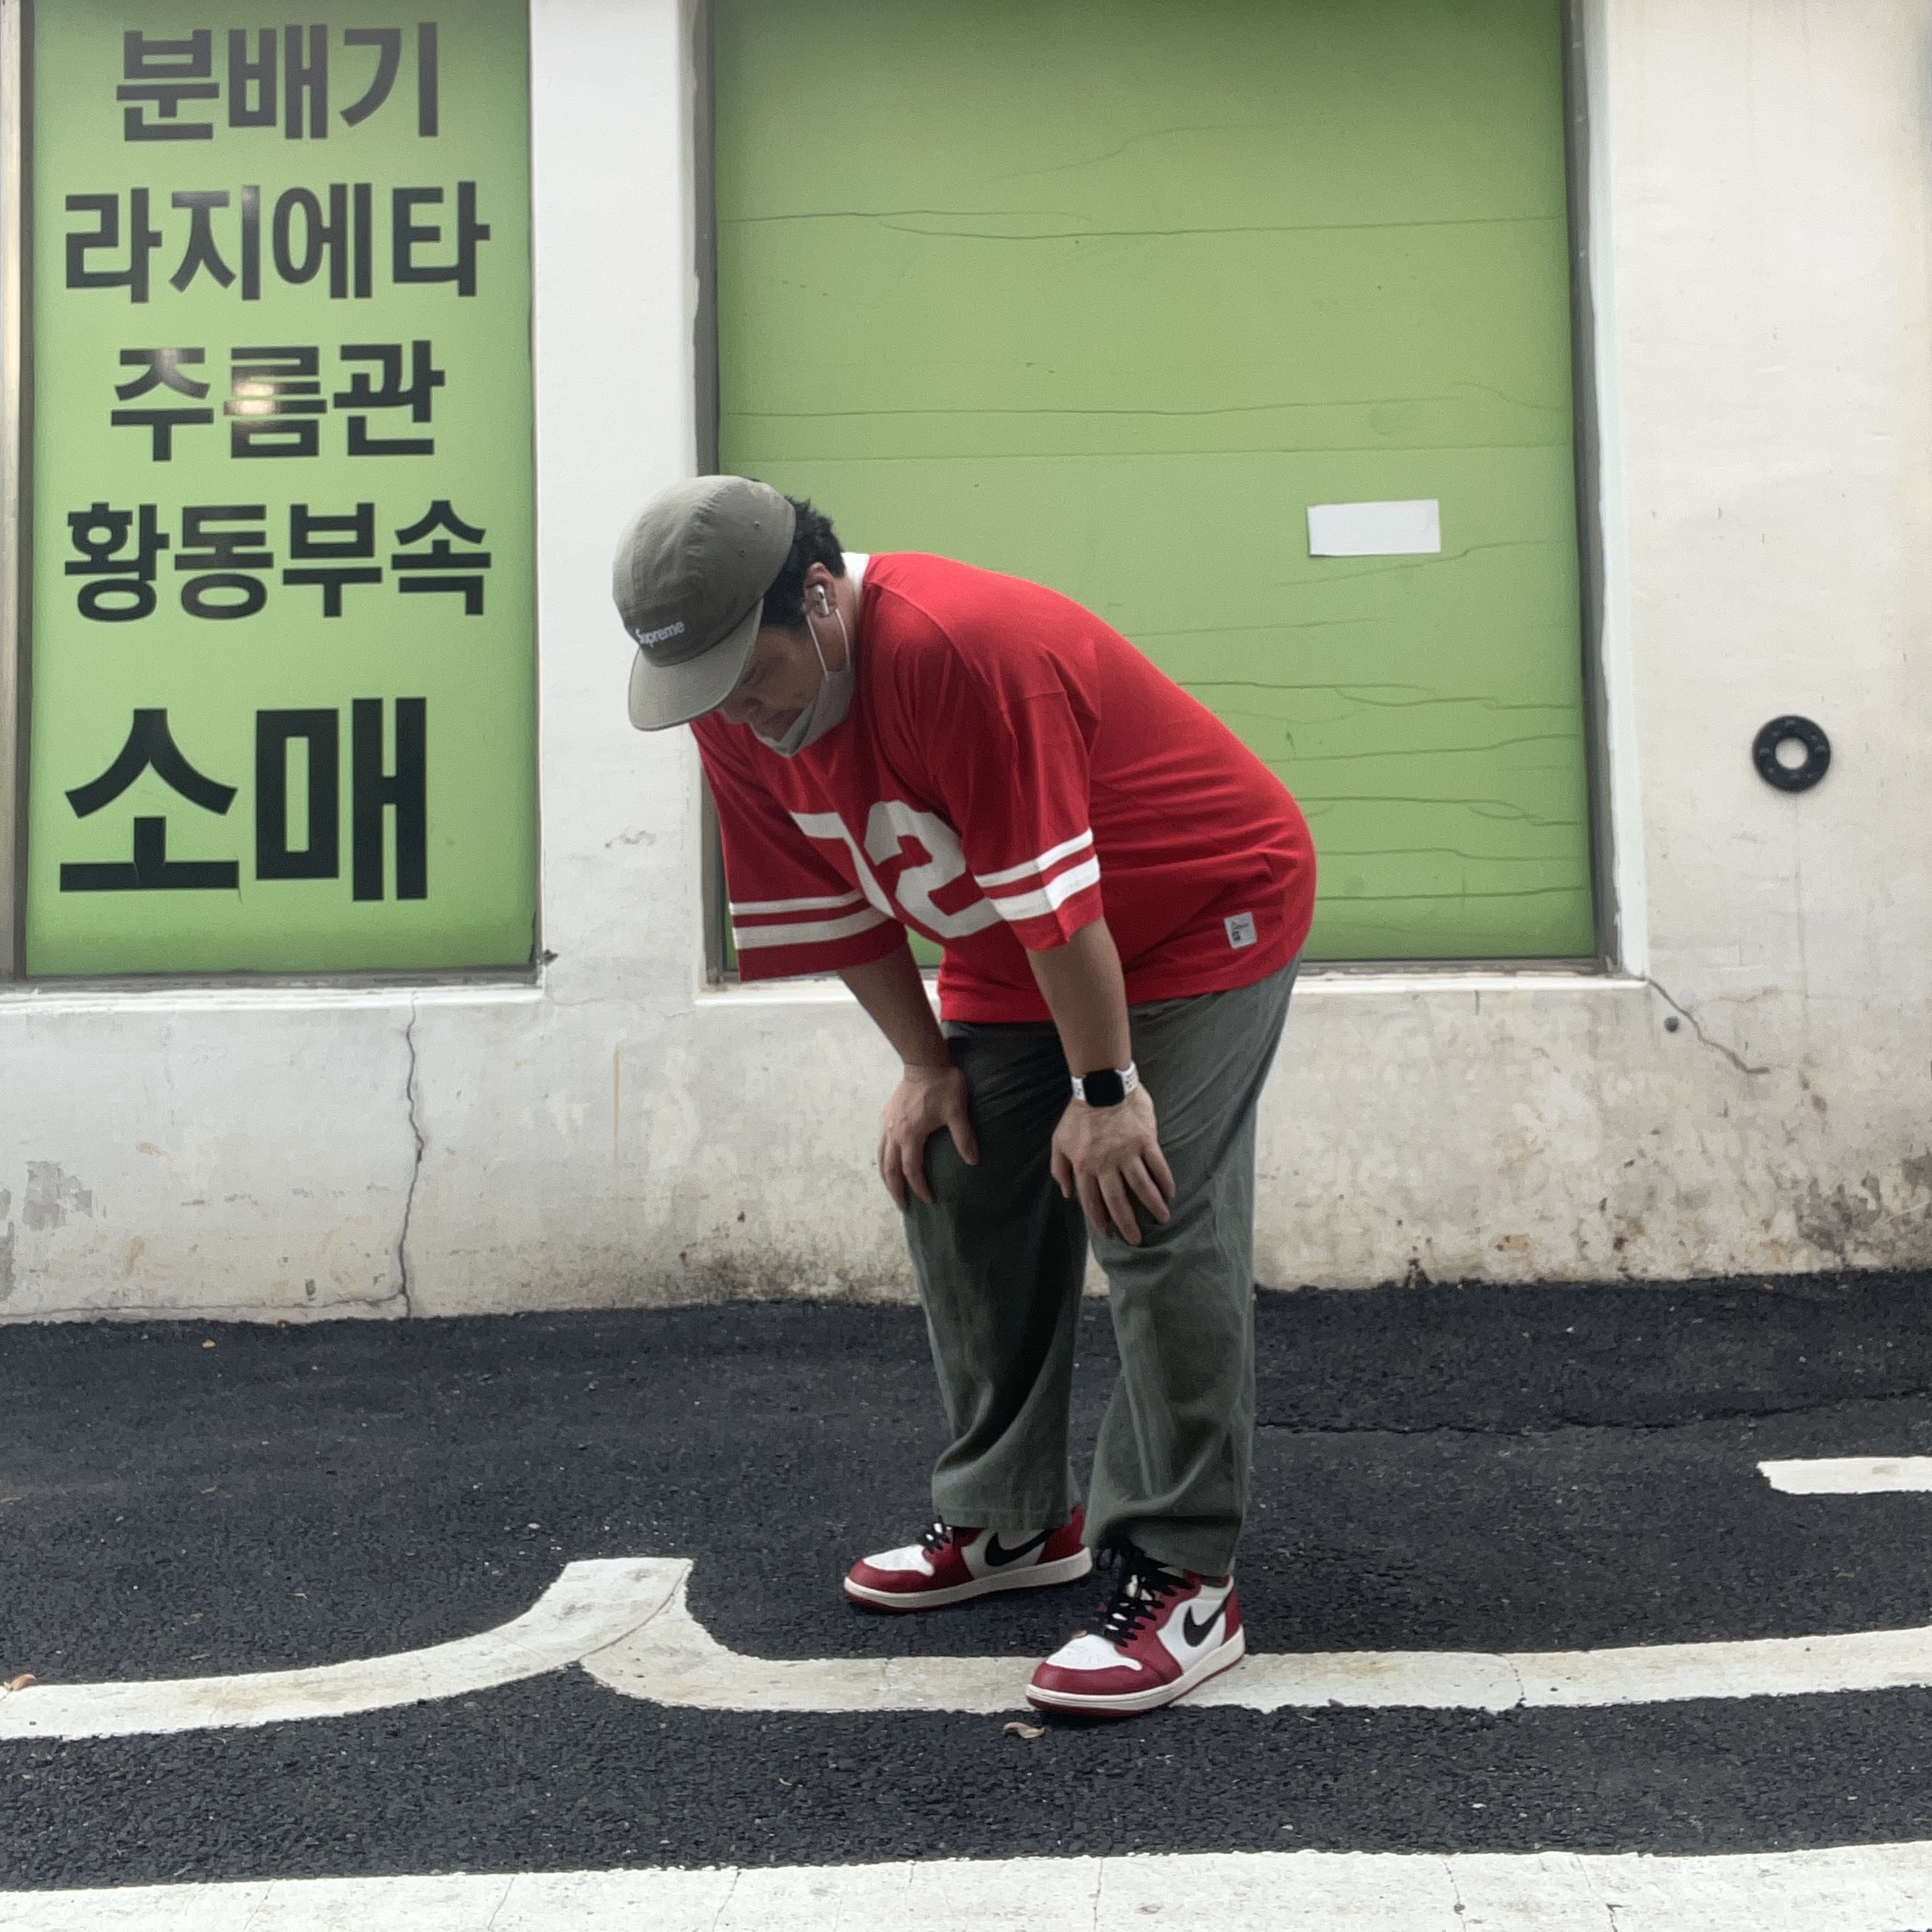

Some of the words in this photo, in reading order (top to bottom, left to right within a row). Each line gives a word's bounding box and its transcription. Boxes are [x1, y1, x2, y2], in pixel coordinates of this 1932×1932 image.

[116, 22, 438, 142] 분배기
[65, 181, 491, 304] 라지에타
[111, 340, 445, 462] 주름관
[64, 500, 491, 622] 황동부속
[60, 697, 427, 902] 소매
[789, 799, 1005, 939] 72
